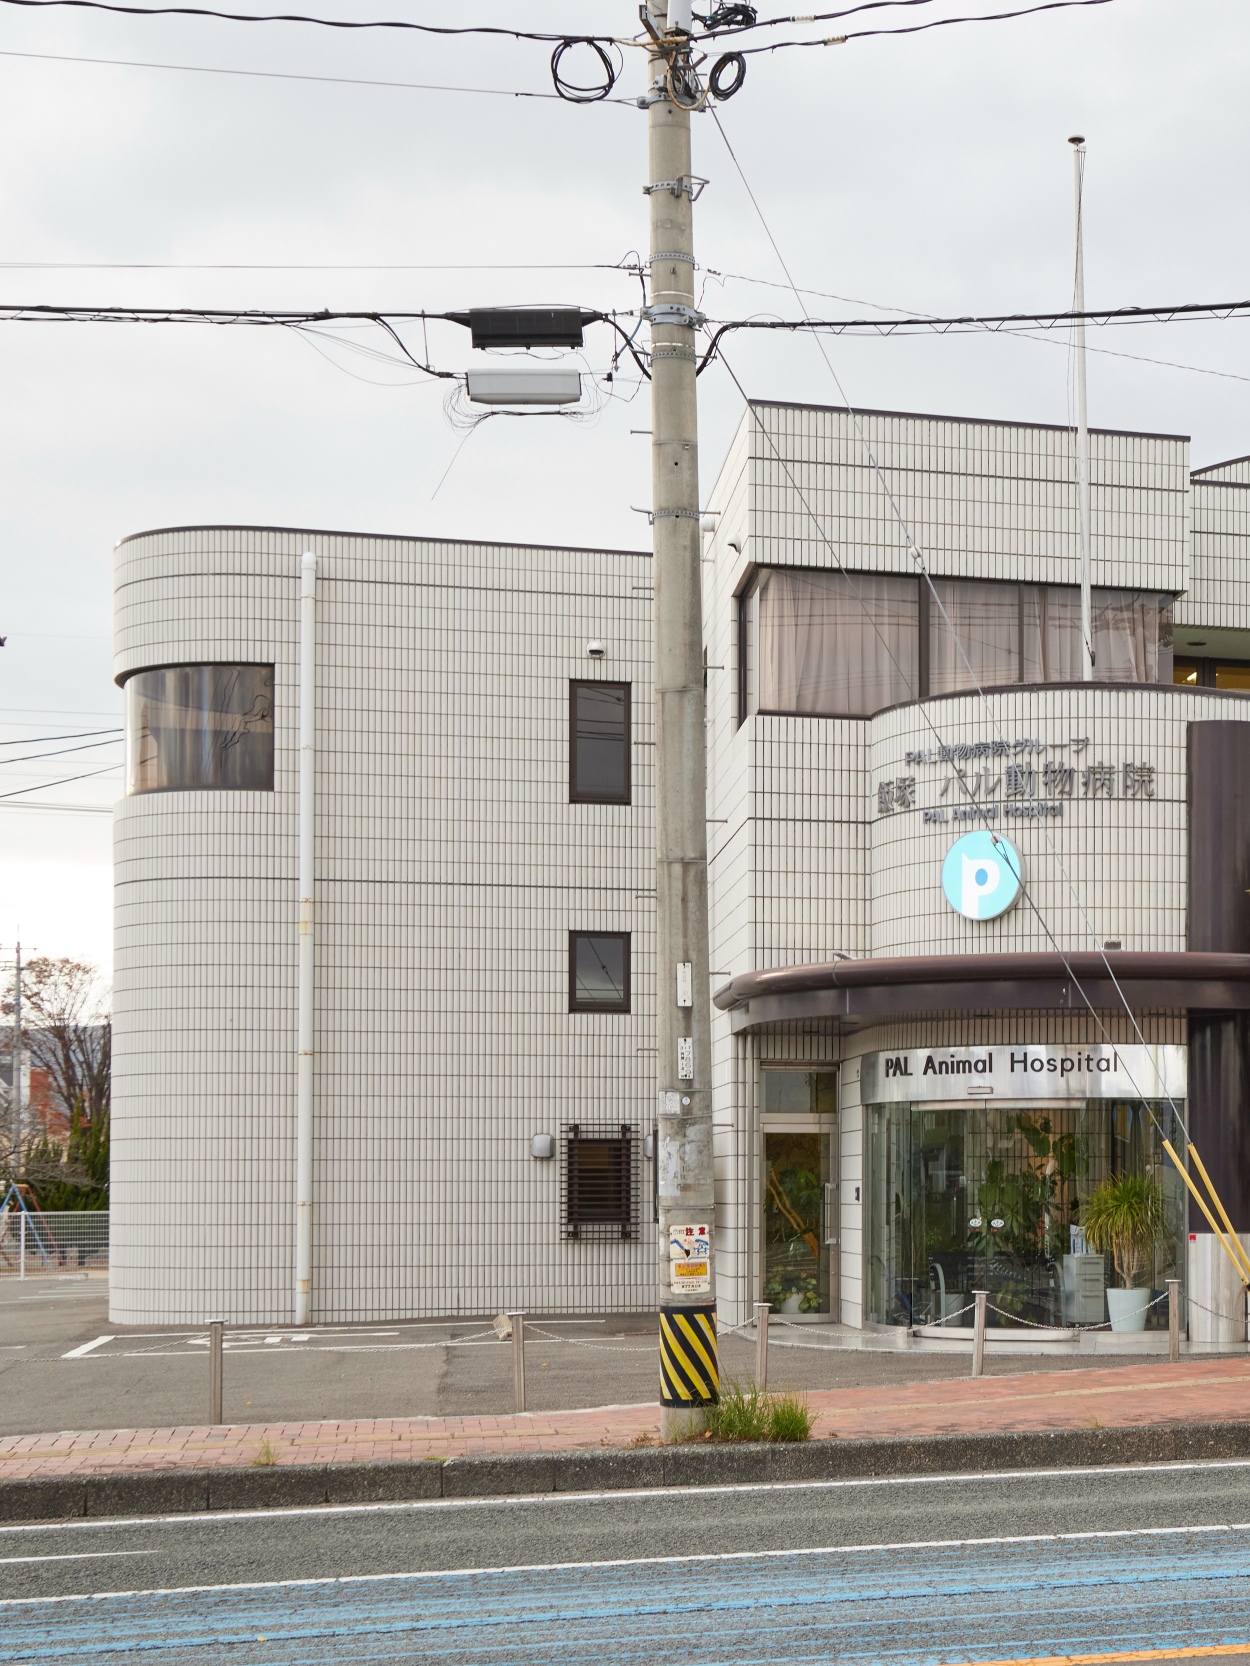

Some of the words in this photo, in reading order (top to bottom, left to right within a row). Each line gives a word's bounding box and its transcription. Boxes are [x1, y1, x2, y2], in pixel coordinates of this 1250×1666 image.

[904, 736, 1090, 767] PAL動物病院グループ
[877, 774, 916, 814] 飯塚
[939, 760, 1156, 798] パル動物病院
[922, 809, 949, 824] PAL
[951, 804, 998, 821] Animal
[1003, 801, 1064, 819] Hospital
[885, 1056, 913, 1078] PAL
[922, 1052, 993, 1076] Animal
[1010, 1051, 1118, 1077] Hospital
